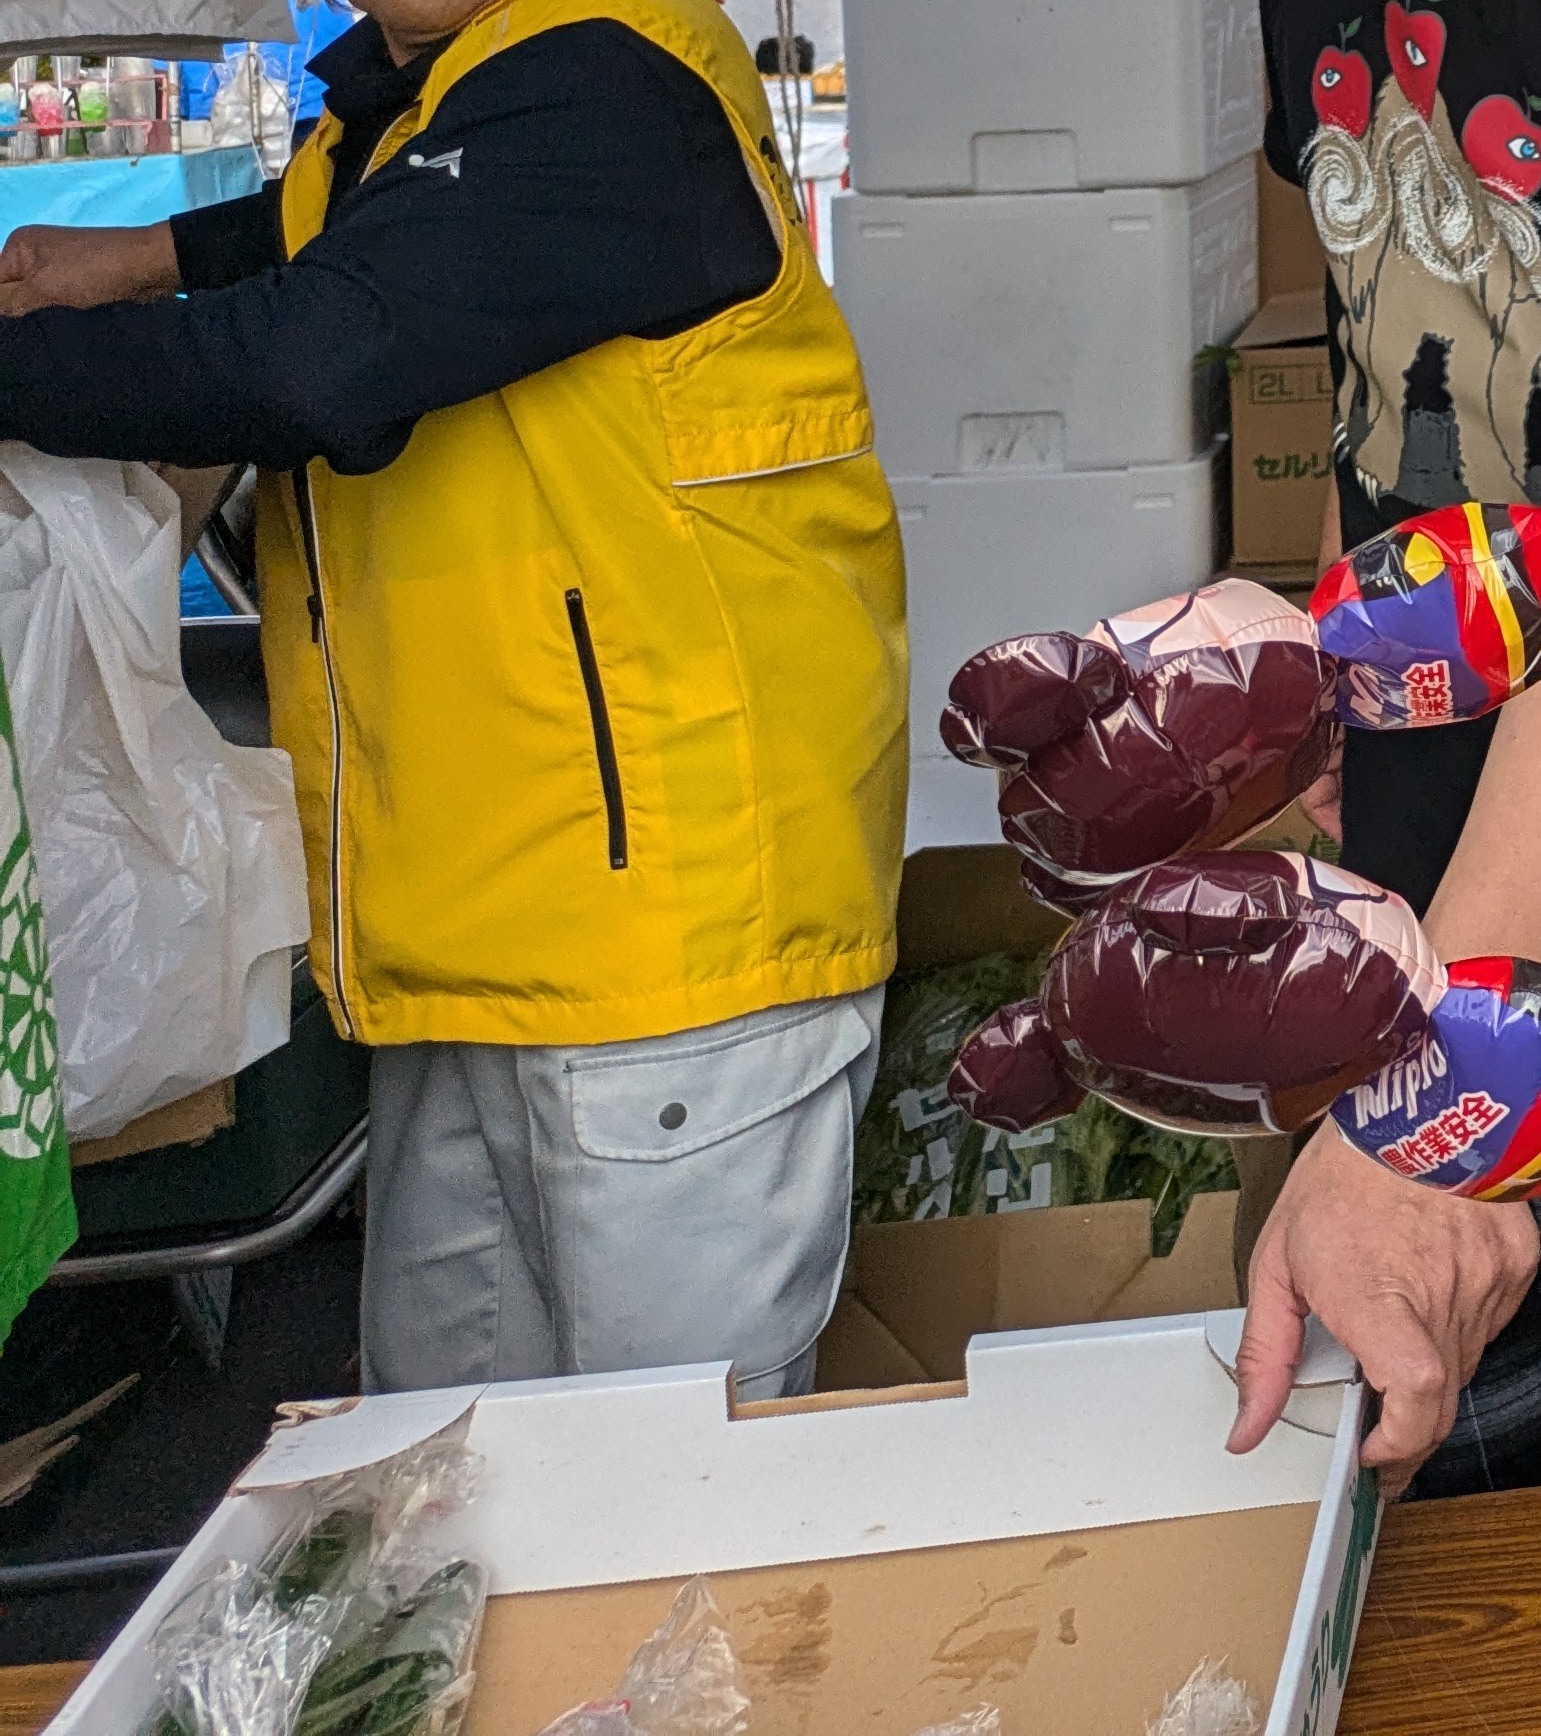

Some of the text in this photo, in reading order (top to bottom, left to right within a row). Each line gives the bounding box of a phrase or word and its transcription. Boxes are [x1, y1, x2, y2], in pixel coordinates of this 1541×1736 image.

[1258, 372, 1294, 397] 2L
[1346, 1038, 1448, 1130] Niplo
[1378, 1090, 1511, 1177] 農作業安全
